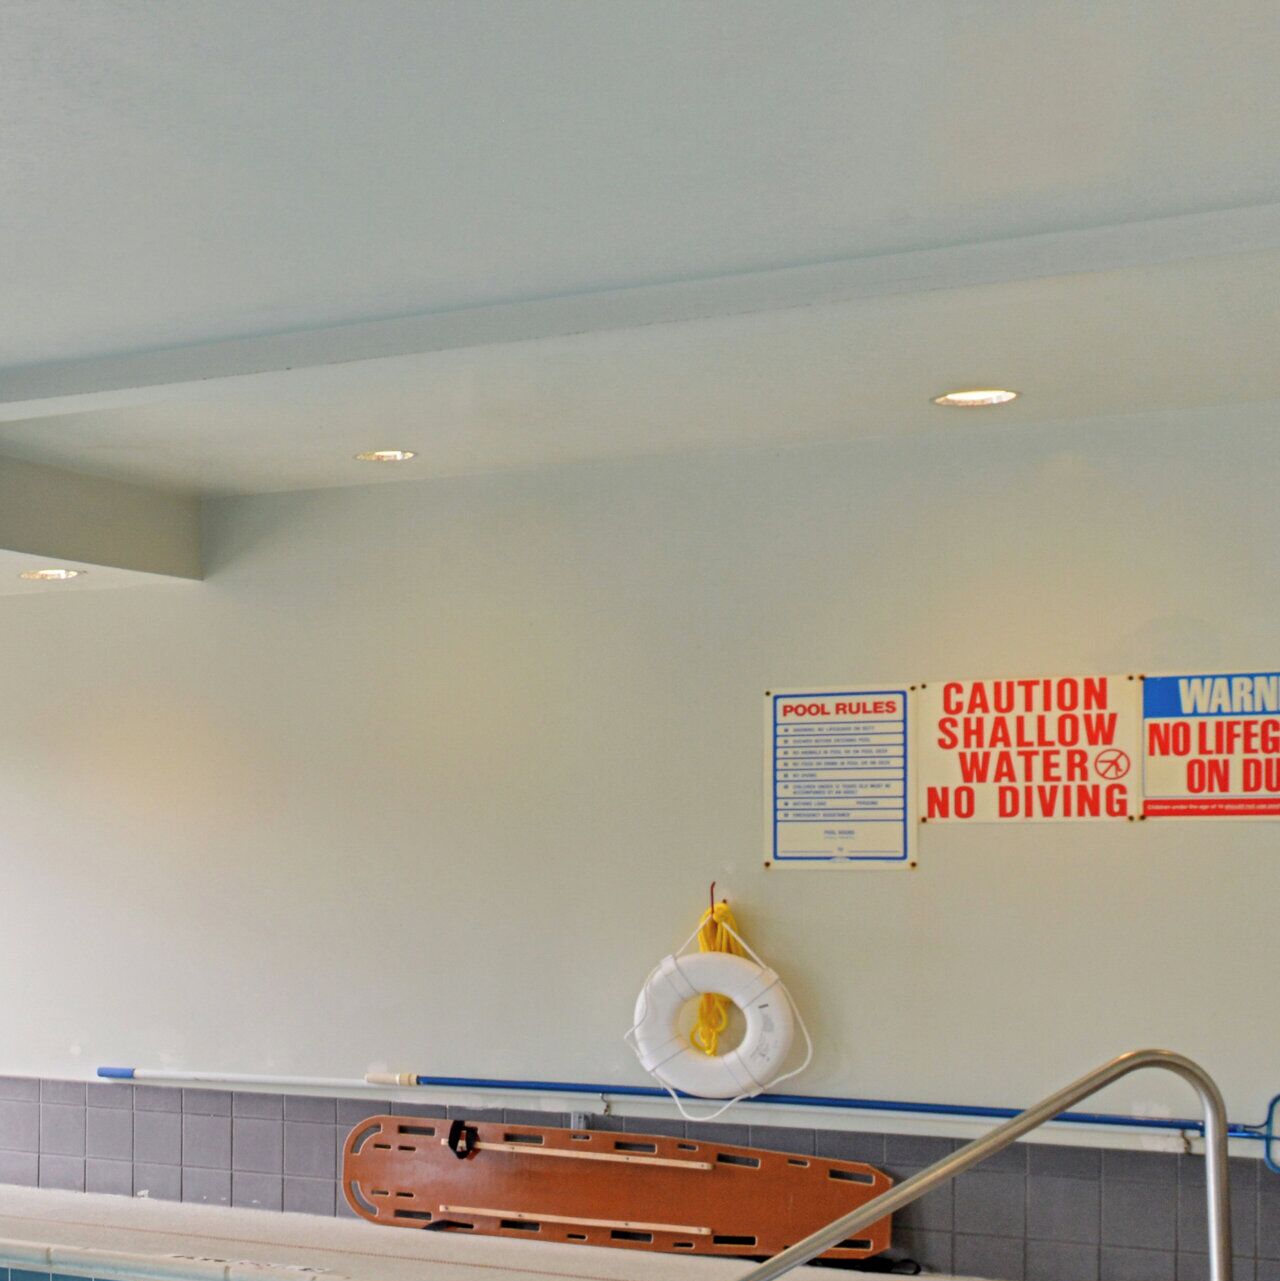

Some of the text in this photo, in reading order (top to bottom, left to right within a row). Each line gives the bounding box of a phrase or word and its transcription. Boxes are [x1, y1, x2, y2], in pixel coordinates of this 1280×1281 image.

[782, 700, 897, 717] POOL RULES
[942, 676, 1109, 716] CAUTION
[1178, 676, 1280, 715] WARN
[937, 711, 1120, 751] SHALLOW
[1148, 718, 1280, 757] NO LIFEG
[958, 748, 1089, 785] WATER
[1186, 757, 1280, 795] ON DU
[927, 782, 1130, 820] NO DIVING
